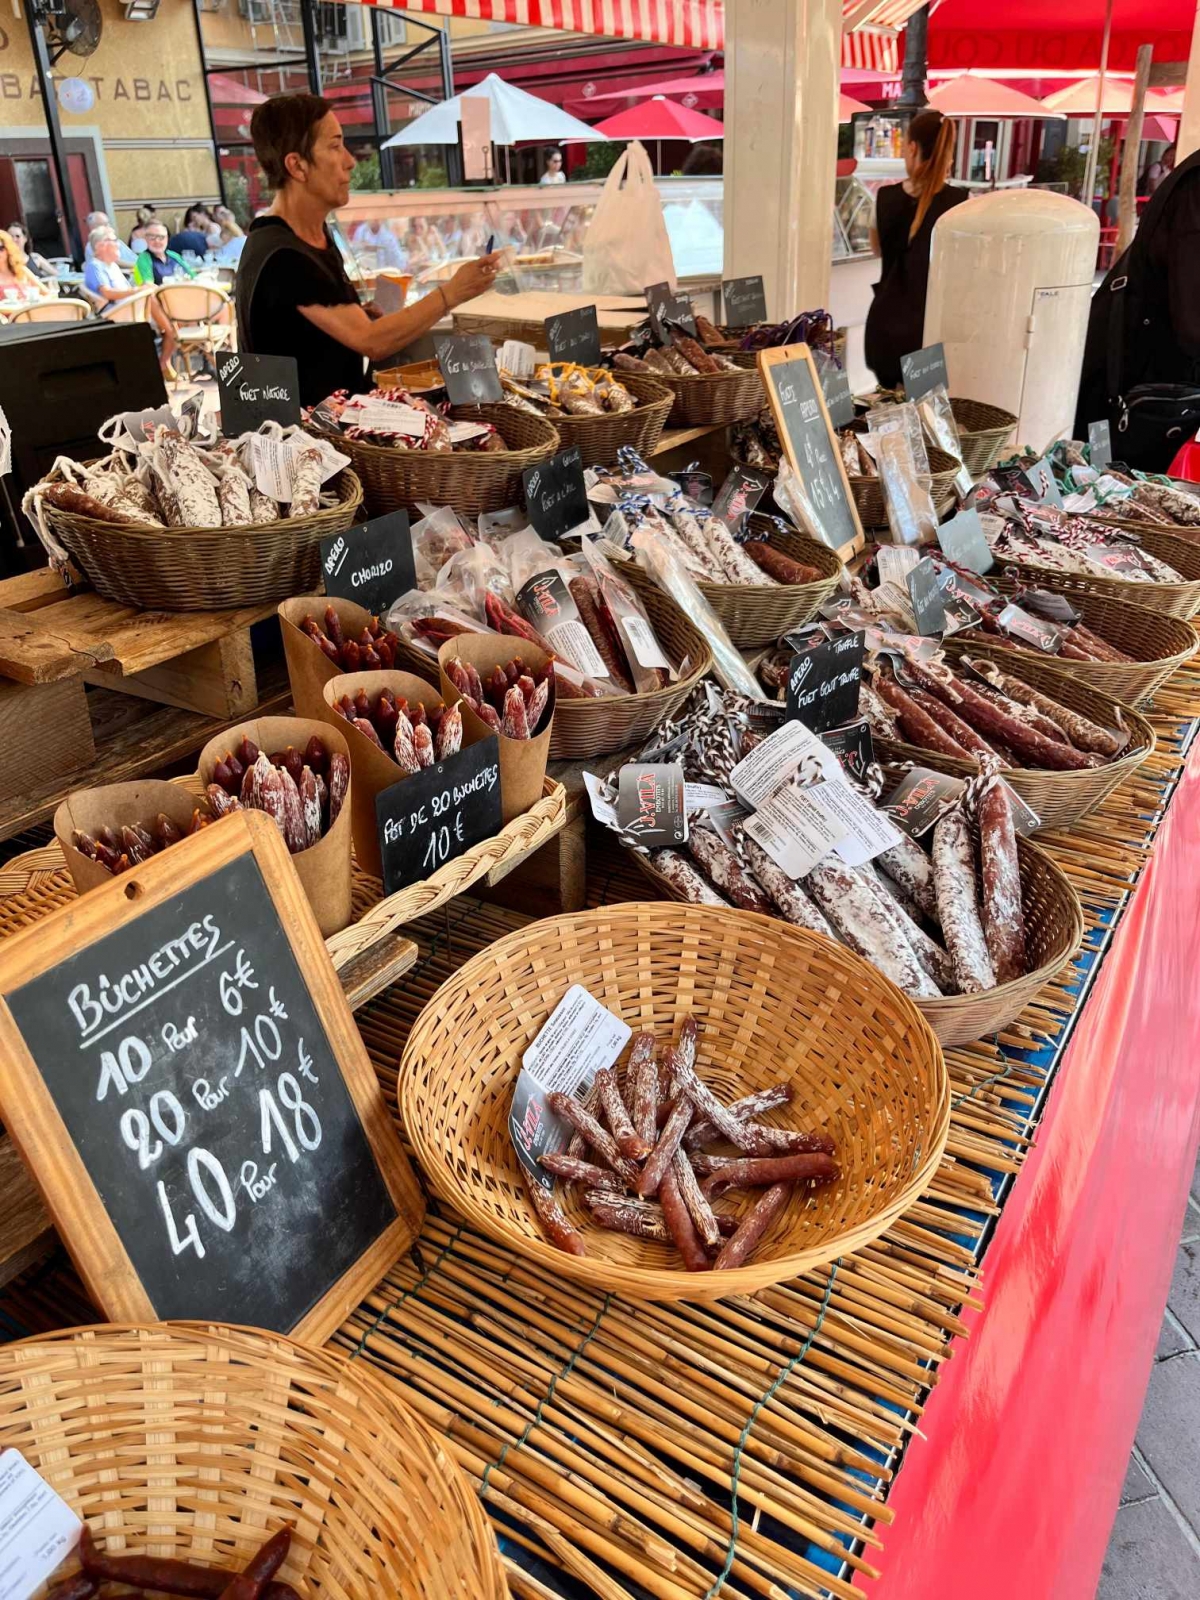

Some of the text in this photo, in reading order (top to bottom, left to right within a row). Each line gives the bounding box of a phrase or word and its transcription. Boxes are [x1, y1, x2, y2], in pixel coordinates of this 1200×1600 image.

[89, 77, 191, 101] TABAC
[219, 355, 240, 381] APERO
[239, 382, 291, 401] FUET NATURE
[324, 536, 345, 575] APERO
[351, 559, 393, 587] CHORIZO
[833, 635, 859, 654] TRUFFLE
[790, 656, 811, 691] APERO
[798, 667, 860, 708] FUET GOUT TRUFFE
[383, 764, 498, 844] POT DE 20 BUCHETTES
[68, 914, 222, 1037] BÛCHETTES
[97, 1036, 152, 1101] 10
[161, 1016, 199, 1052] Pour
[120, 1090, 186, 1170] 20
[192, 1076, 231, 1110] Pour
[157, 1147, 237, 1259] 40
[240, 1160, 279, 1202] Pour
